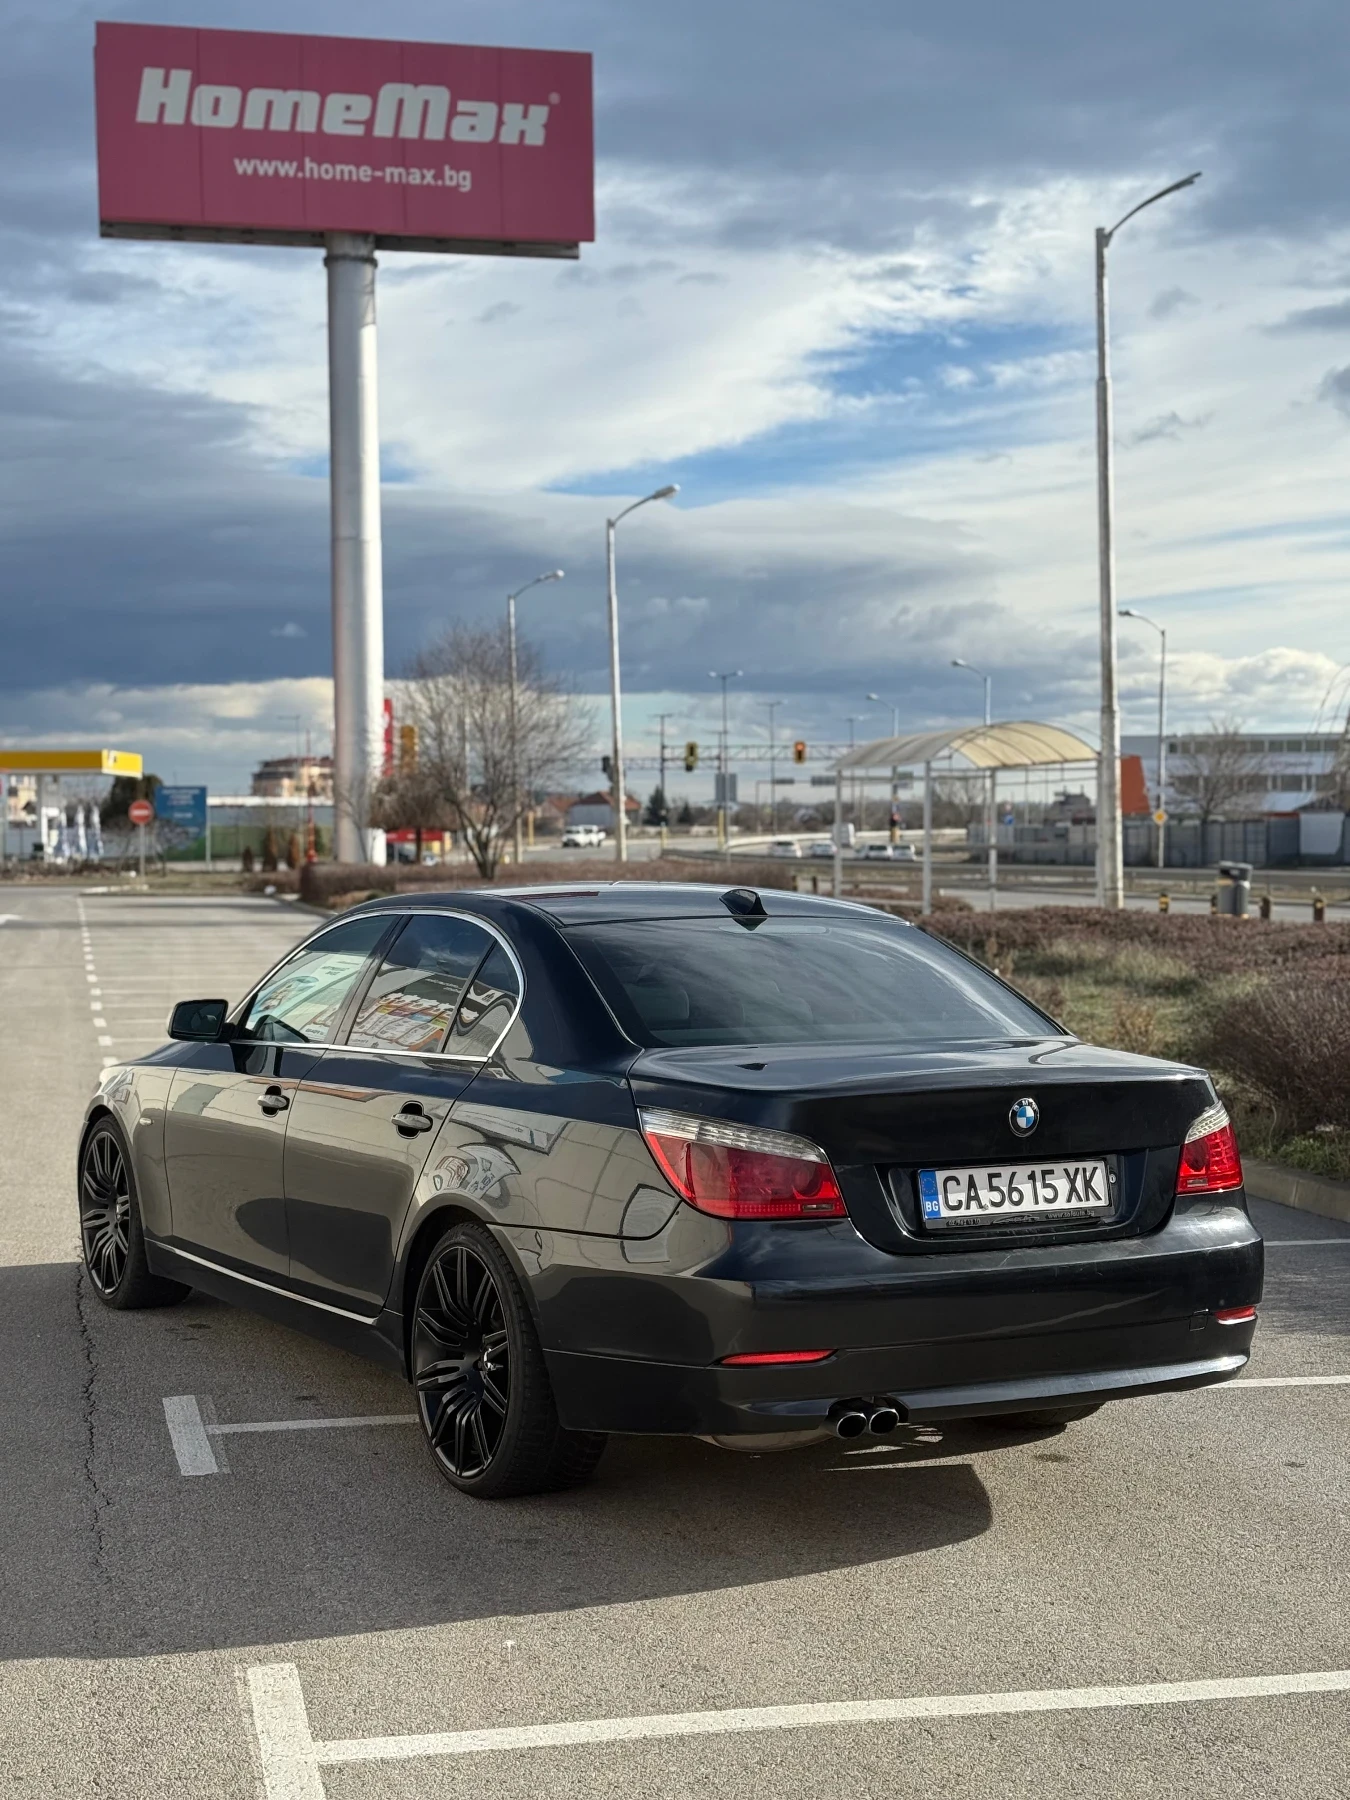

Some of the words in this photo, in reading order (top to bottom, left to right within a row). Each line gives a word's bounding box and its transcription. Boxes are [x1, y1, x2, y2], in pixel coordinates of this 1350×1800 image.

[135, 66, 550, 146] HomeMax
[233, 156, 472, 193] www.home-max.bg
[925, 1200, 939, 1212] BG
